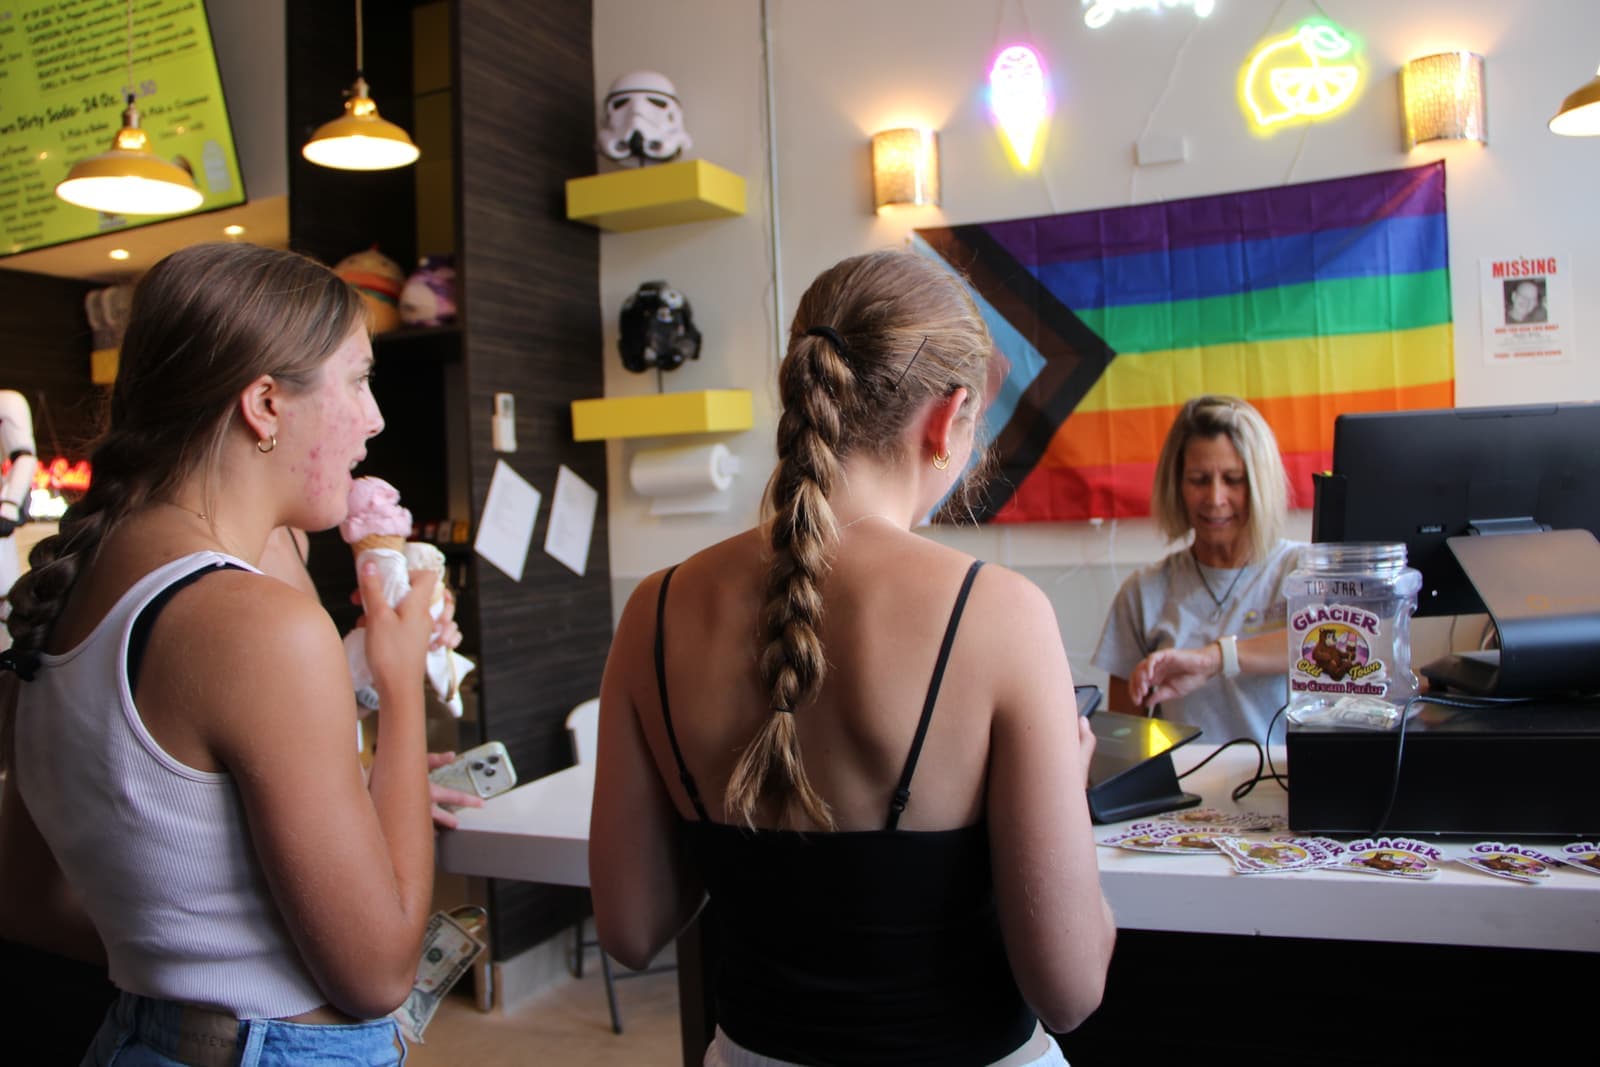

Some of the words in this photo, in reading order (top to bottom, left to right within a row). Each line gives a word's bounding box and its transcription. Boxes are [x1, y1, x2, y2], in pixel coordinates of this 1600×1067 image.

[81, 95, 98, 113] 24
[1492, 257, 1557, 278] MISSING
[1304, 580, 1325, 596] TIP
[1293, 608, 1378, 634] GLACIER
[1297, 660, 1323, 678] Old
[1349, 661, 1381, 680] Town
[1308, 680, 1345, 693] Cream
[1346, 681, 1384, 695] Parlor
[1349, 839, 1440, 861] GLACIER
